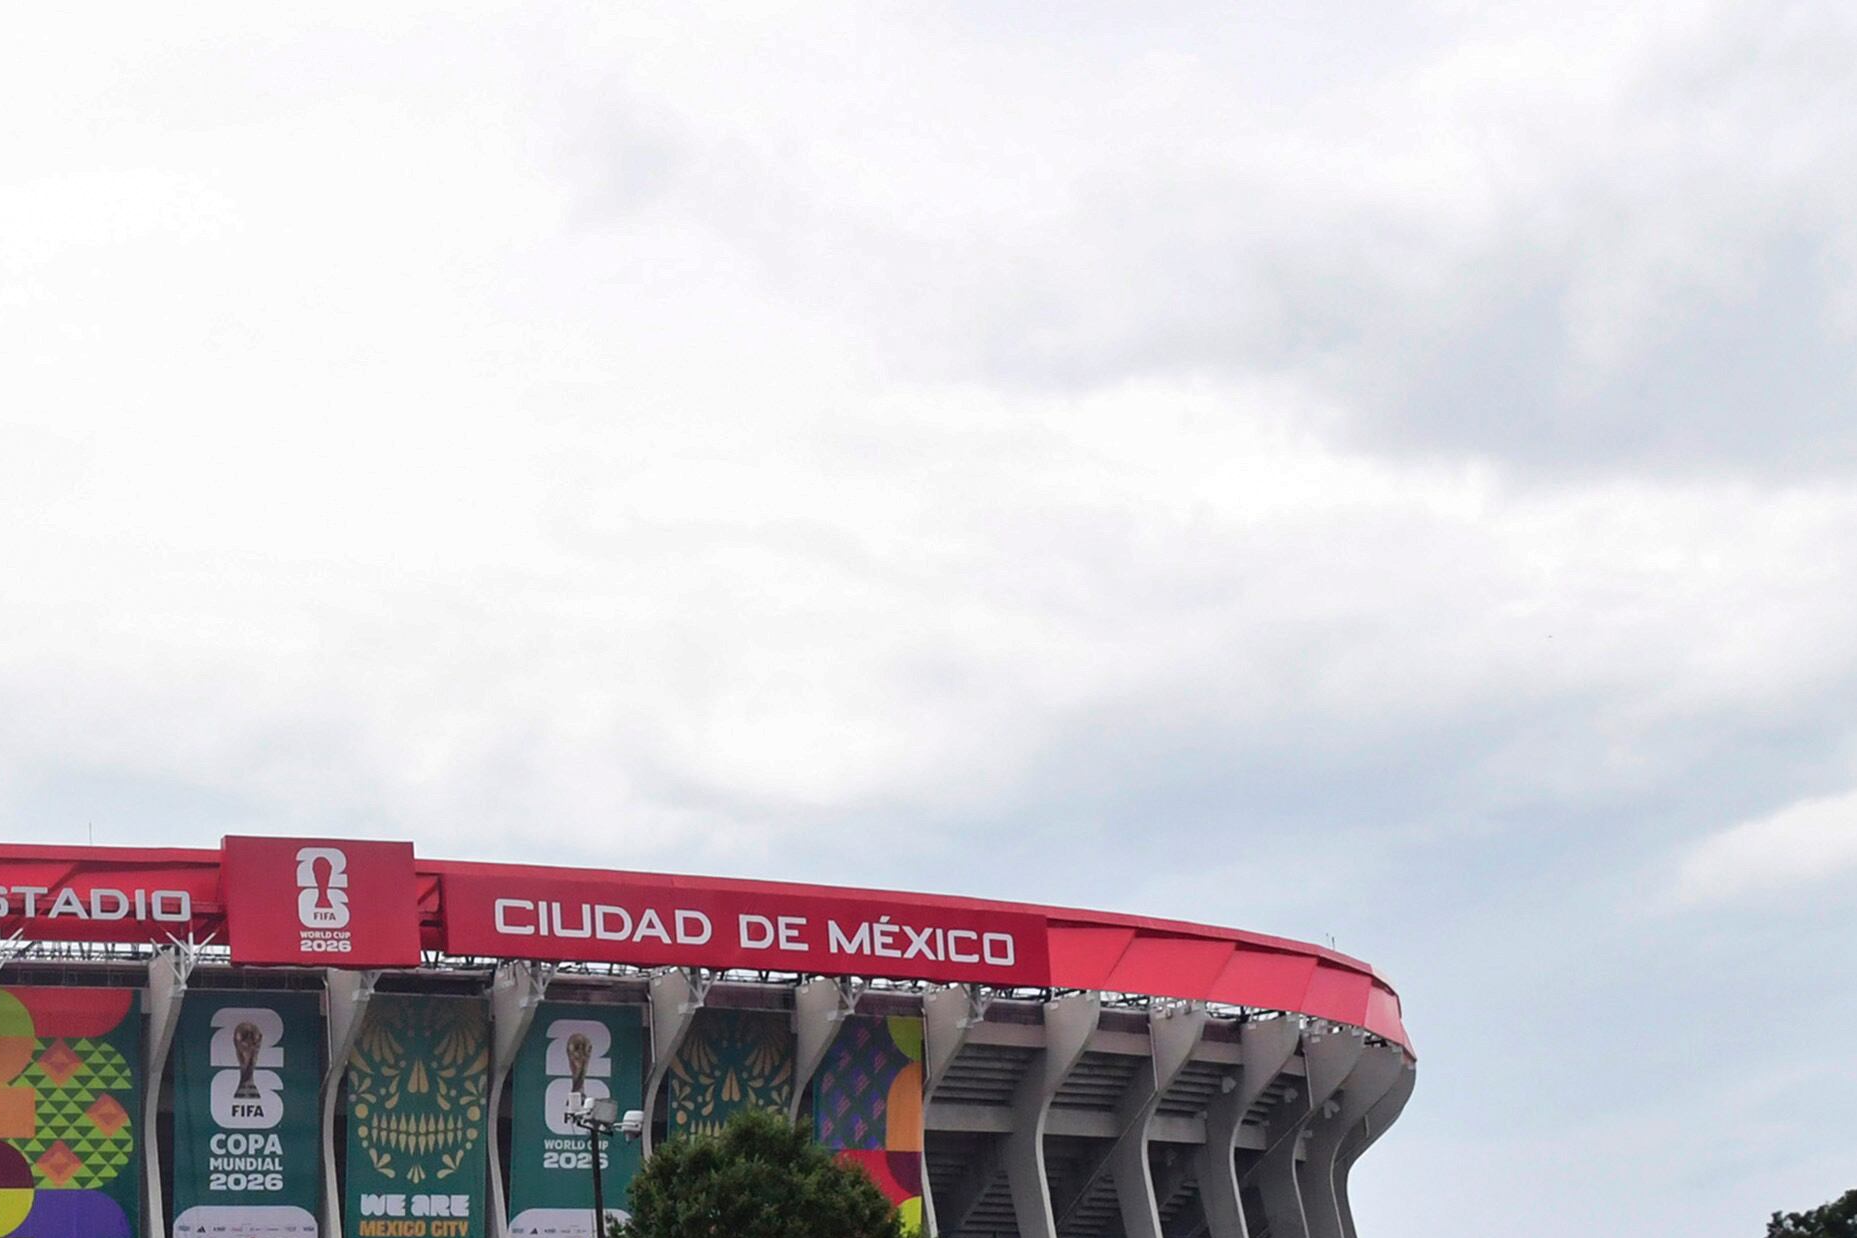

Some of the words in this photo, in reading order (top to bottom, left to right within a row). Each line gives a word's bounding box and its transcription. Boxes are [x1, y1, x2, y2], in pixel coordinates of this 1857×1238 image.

[313, 912, 336, 920] FIFA
[333, 931, 351, 939] CUP
[494, 898, 712, 945] CIUDAD
[738, 914, 809, 952] DE
[828, 916, 1016, 966] MÉXICO
[300, 940, 352, 952] 2026
[232, 1105, 264, 1117] FIFA
[210, 1133, 283, 1155] COPA
[544, 1139, 585, 1150] WORLD
[210, 1157, 283, 1171] MUNDIAL
[209, 1172, 283, 1191] 2026
[360, 1193, 406, 1216] WE
[410, 1194, 470, 1217] ARE
[359, 1220, 426, 1237] MEXICO
[431, 1221, 469, 1237] CITY
